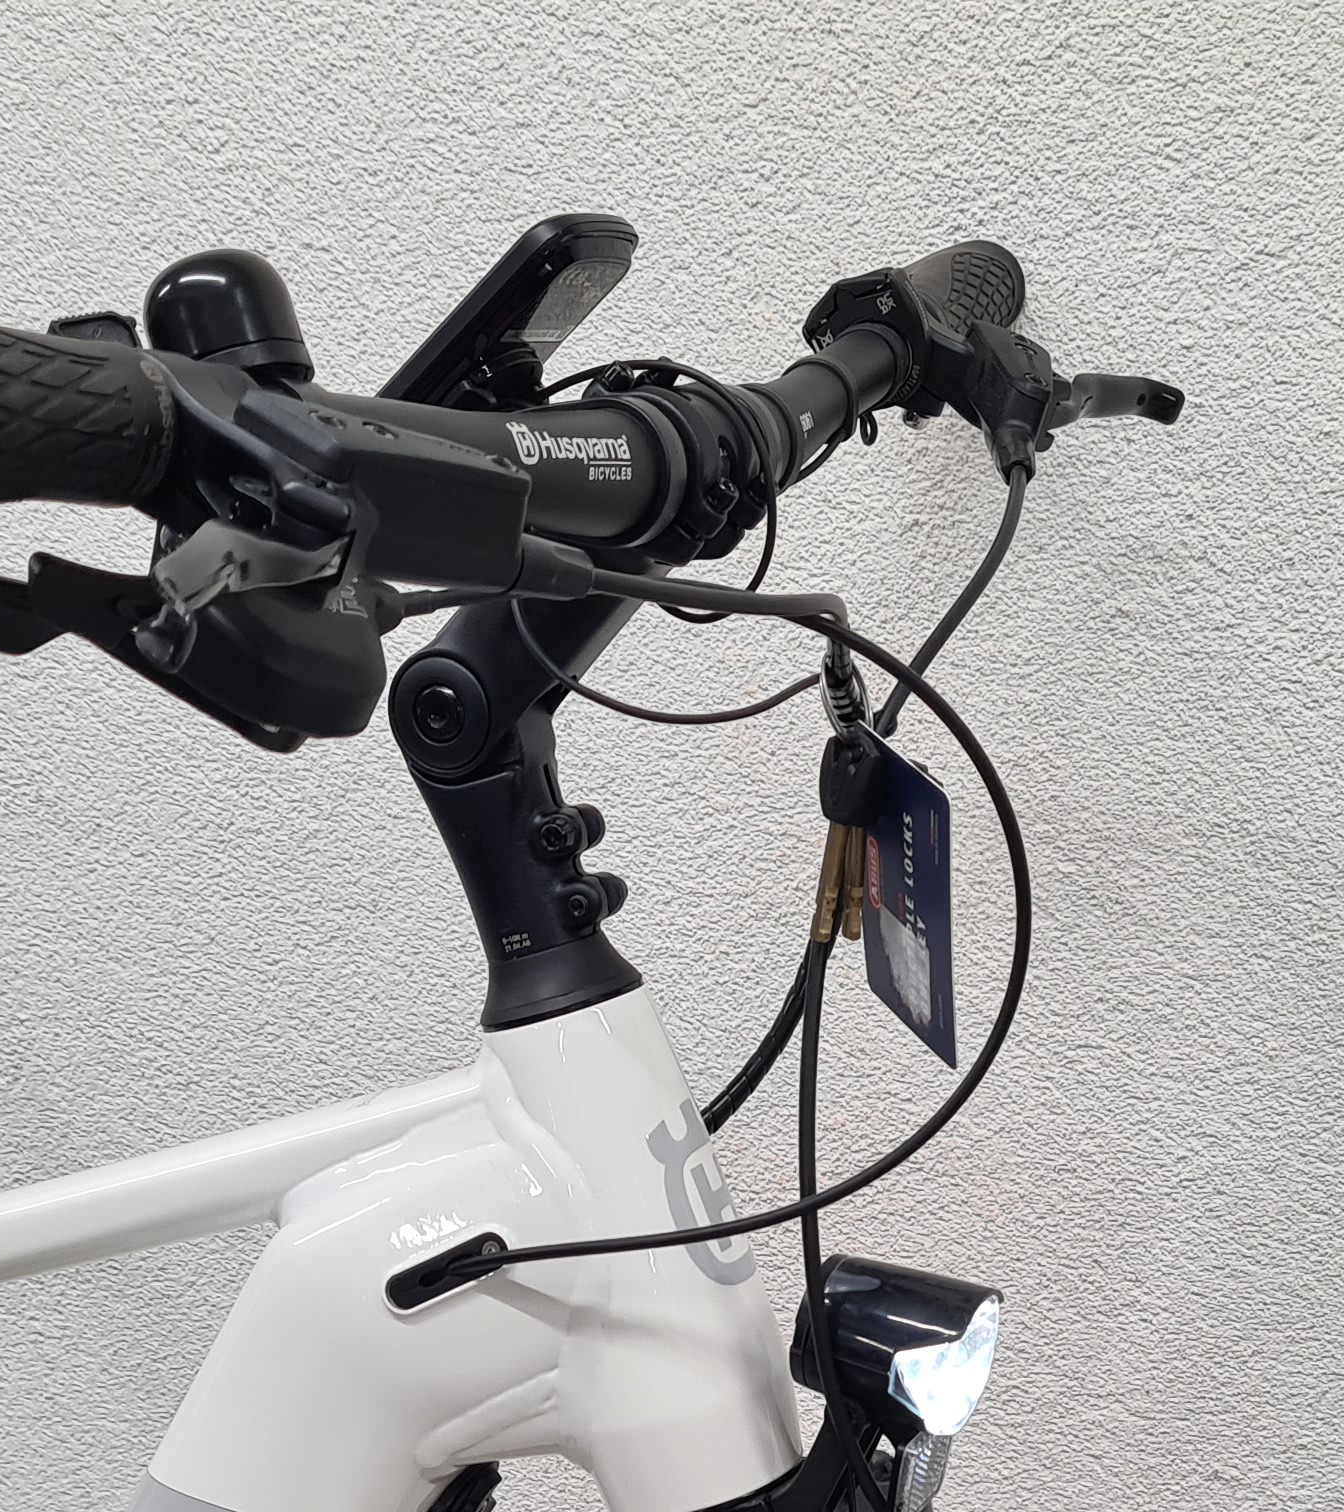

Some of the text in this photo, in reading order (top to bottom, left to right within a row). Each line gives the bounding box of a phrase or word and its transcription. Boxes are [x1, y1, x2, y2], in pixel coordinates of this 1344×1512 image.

[535, 431, 632, 465] Husqvarna
[588, 466, 633, 481] BICYCLES
[903, 812, 915, 888] LOCKS
